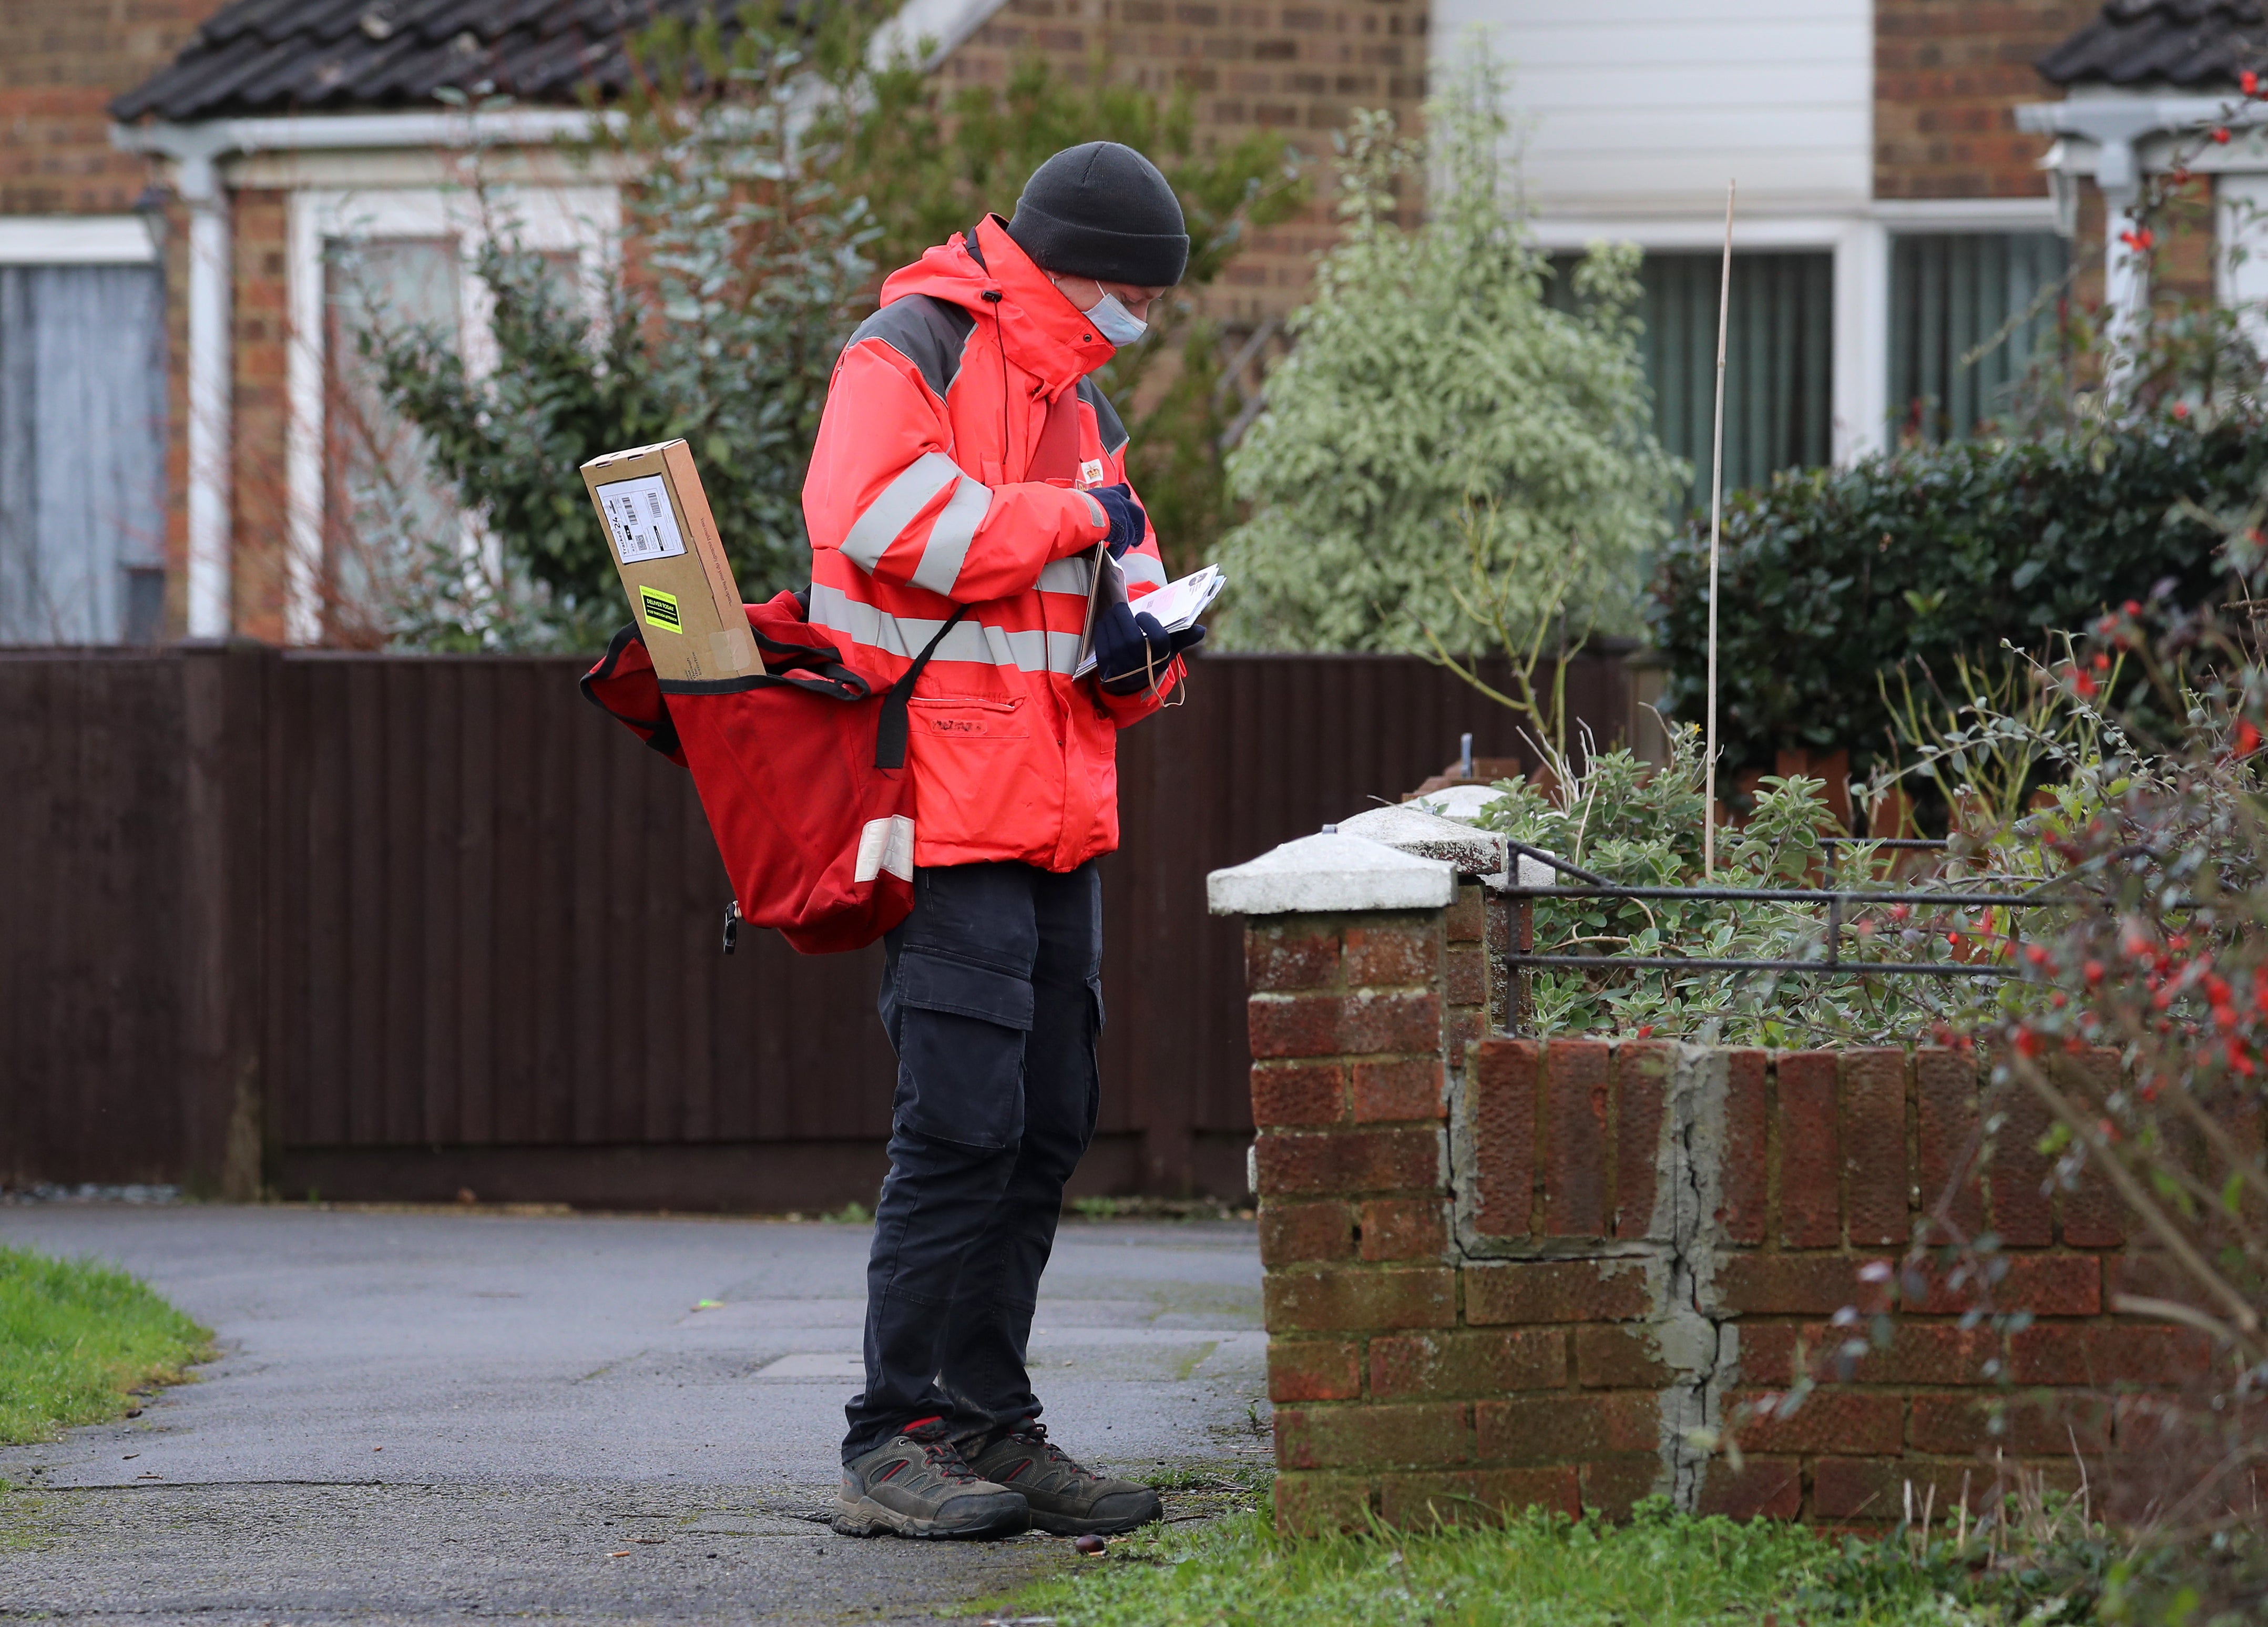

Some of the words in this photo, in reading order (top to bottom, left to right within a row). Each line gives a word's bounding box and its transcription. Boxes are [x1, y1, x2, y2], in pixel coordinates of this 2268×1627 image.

[612, 517, 620, 529] 24
[617, 531, 627, 555] Tracked
[708, 541, 718, 562] excitedly
[647, 598, 662, 608] DELIVER
[662, 603, 673, 611] TODAY
